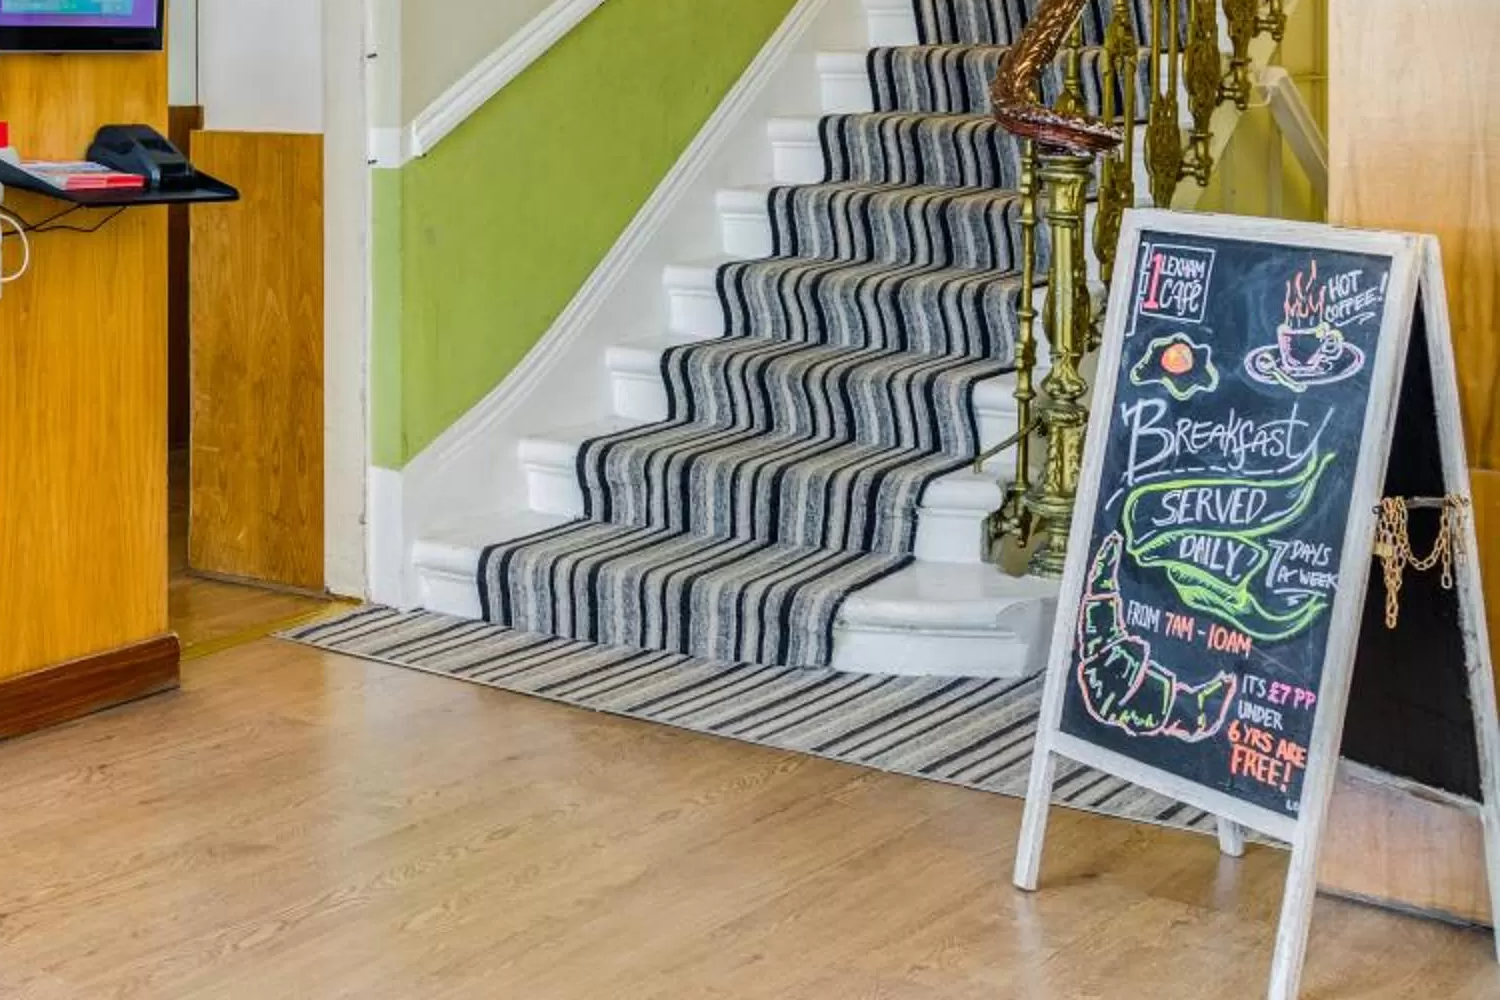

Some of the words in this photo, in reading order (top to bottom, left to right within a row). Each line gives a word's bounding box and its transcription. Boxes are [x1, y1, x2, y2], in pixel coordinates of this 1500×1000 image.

[1160, 255, 1206, 279] LEXHAM
[1328, 269, 1363, 302] HOT
[1152, 487, 1267, 526] SERVED
[1179, 534, 1244, 578] DAILY
[1265, 538, 1290, 588] 7
[1290, 540, 1332, 566] DAYS
[1299, 568, 1340, 592] WEEK
[1126, 599, 1160, 633] FROM
[1165, 611, 1195, 642] 7AM
[1207, 623, 1253, 659] 10AM
[1242, 674, 1266, 698] ITS
[1268, 681, 1291, 705] £7
[1293, 687, 1317, 710] PP
[1238, 699, 1283, 730] UNDER
[1228, 719, 1241, 743] 6
[1243, 723, 1274, 753] YRS
[1276, 737, 1306, 769] ARE
[1230, 743, 1293, 793] FREE!
